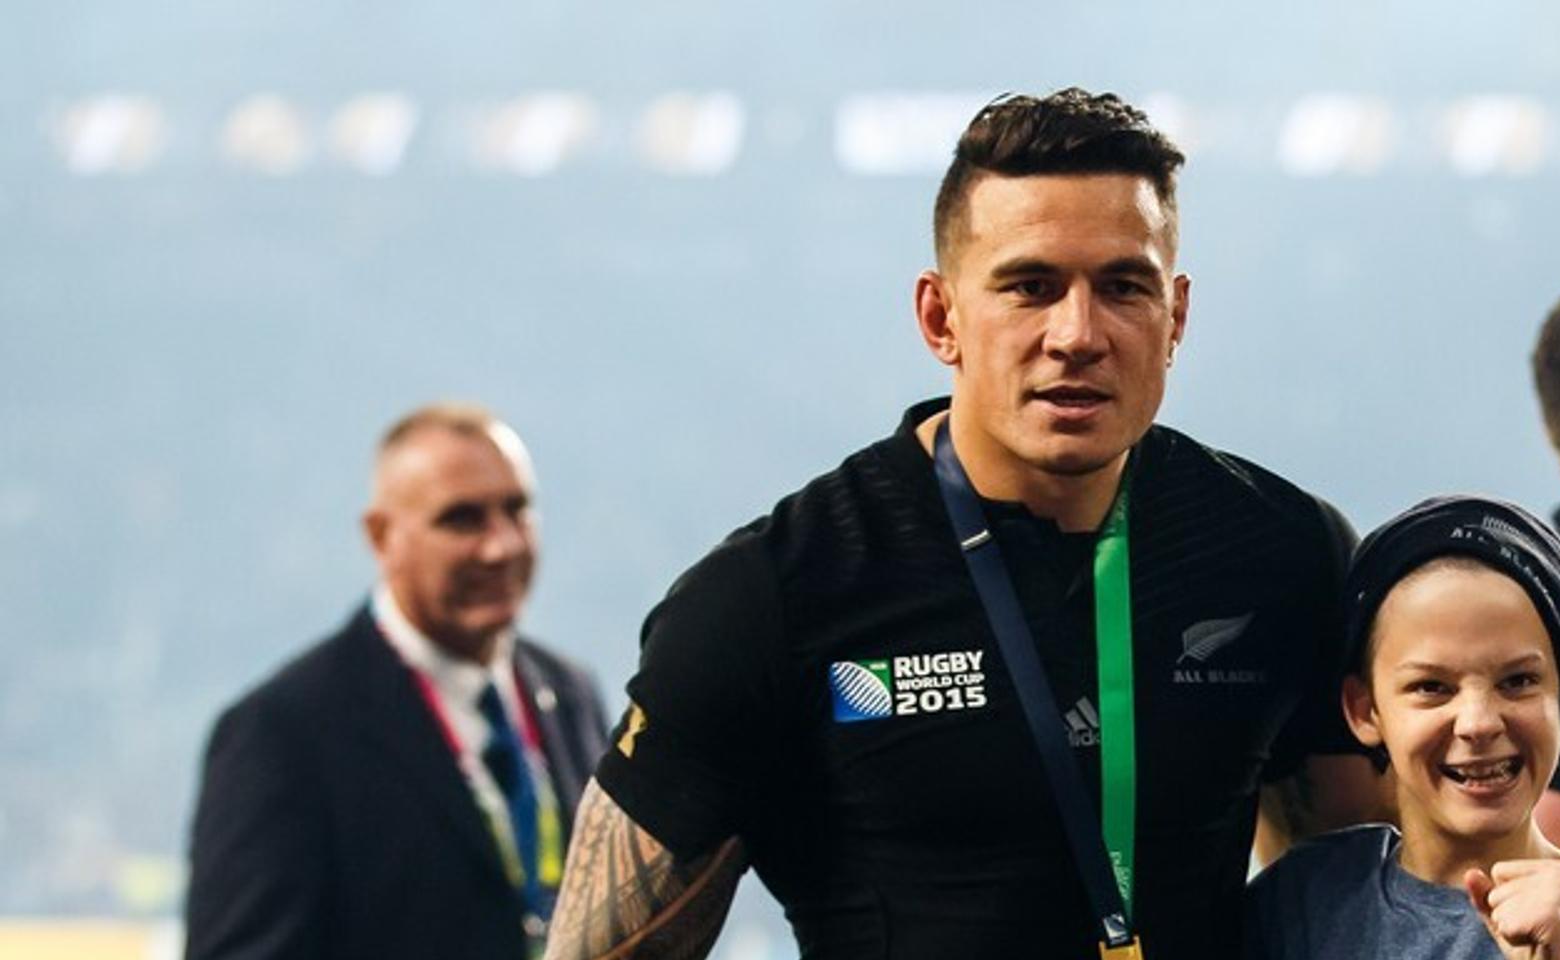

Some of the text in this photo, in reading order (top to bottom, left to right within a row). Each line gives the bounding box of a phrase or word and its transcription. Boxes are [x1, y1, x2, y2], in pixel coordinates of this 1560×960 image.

[893, 650, 984, 678] RUGBY
[895, 673, 986, 691] WORLD CUP
[895, 685, 988, 716] 2015
